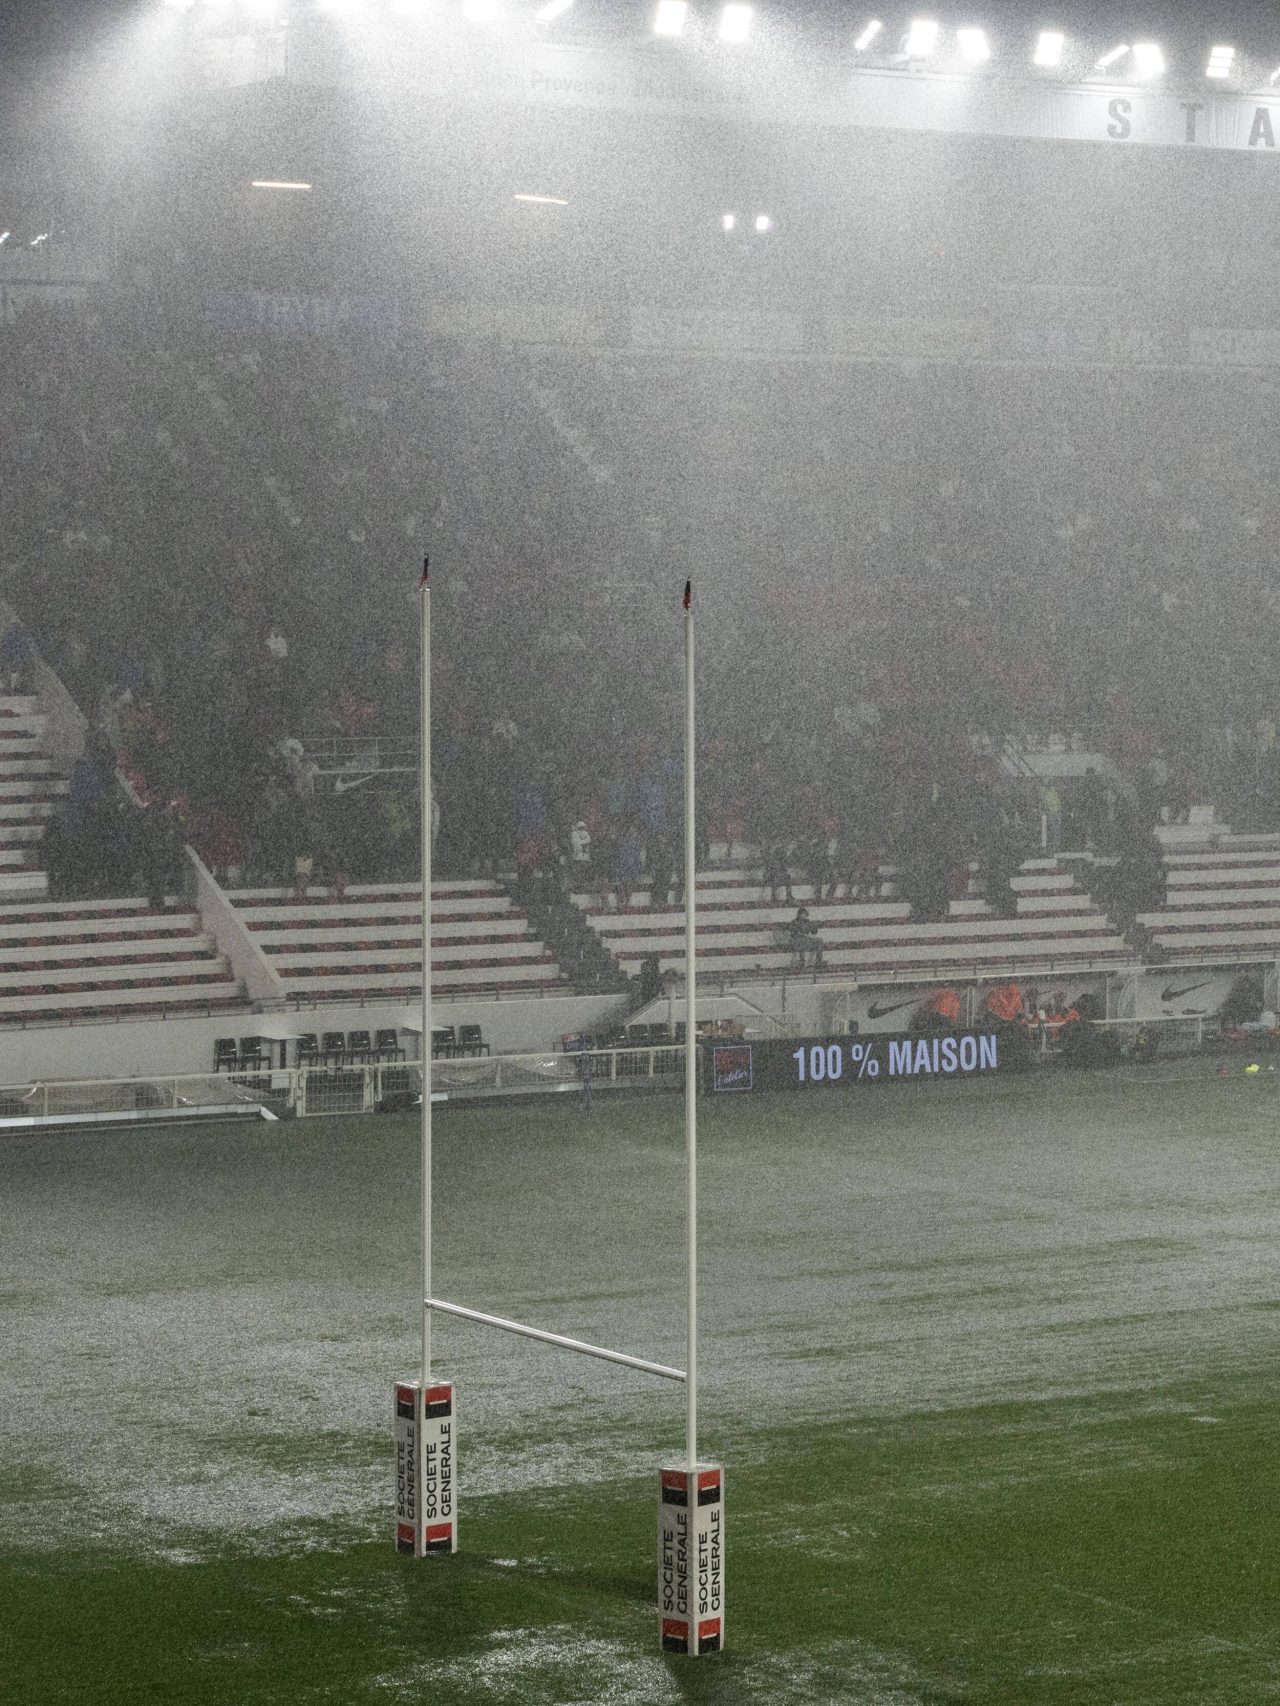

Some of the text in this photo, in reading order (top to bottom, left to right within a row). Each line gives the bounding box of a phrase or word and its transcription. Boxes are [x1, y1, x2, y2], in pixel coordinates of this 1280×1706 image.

[793, 1034, 998, 1081] 100 % MAISON
[407, 1426, 415, 1520] GENERALE
[426, 1442, 437, 1519] SOCIETE
[440, 1422, 452, 1517] GENERALE
[663, 1529, 674, 1612] SOCIETE
[677, 1512, 688, 1614] GENERALE
[699, 1531, 708, 1614] SOCIETE
[710, 1509, 720, 1611] GENERALE
